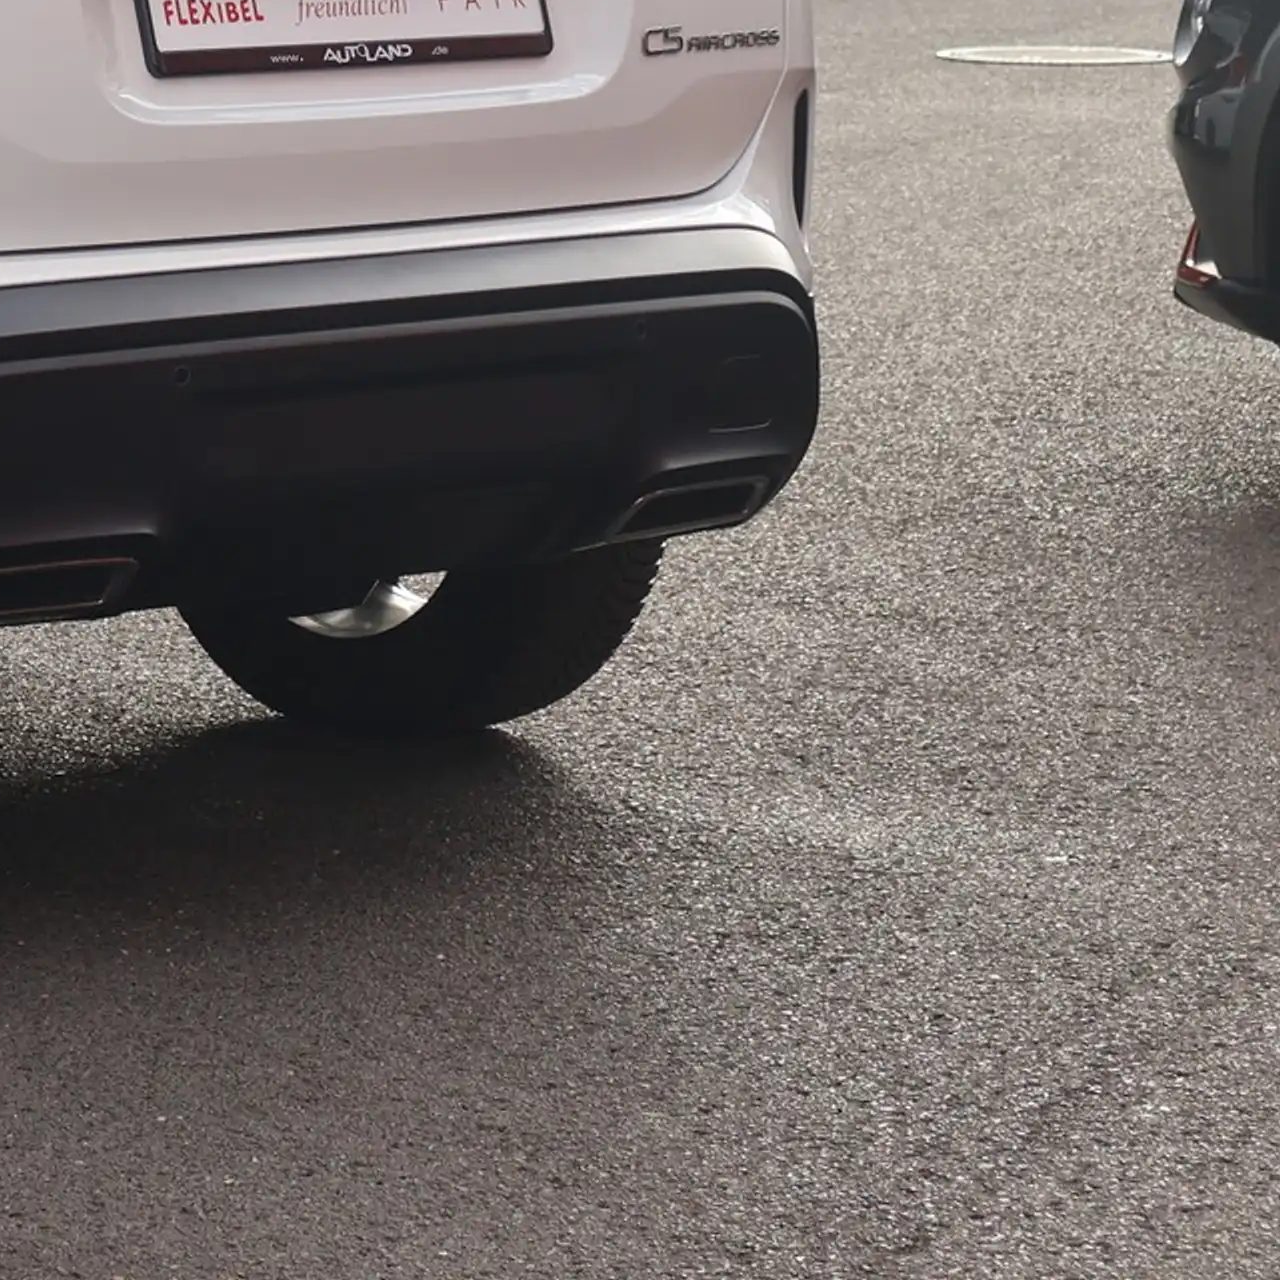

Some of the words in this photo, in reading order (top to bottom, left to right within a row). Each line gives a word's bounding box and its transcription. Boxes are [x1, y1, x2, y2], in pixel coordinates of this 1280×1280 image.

[323, 42, 413, 64] AUTOLAND
[641, 25, 684, 56] C5
[687, 28, 781, 53] AIRCROSS
